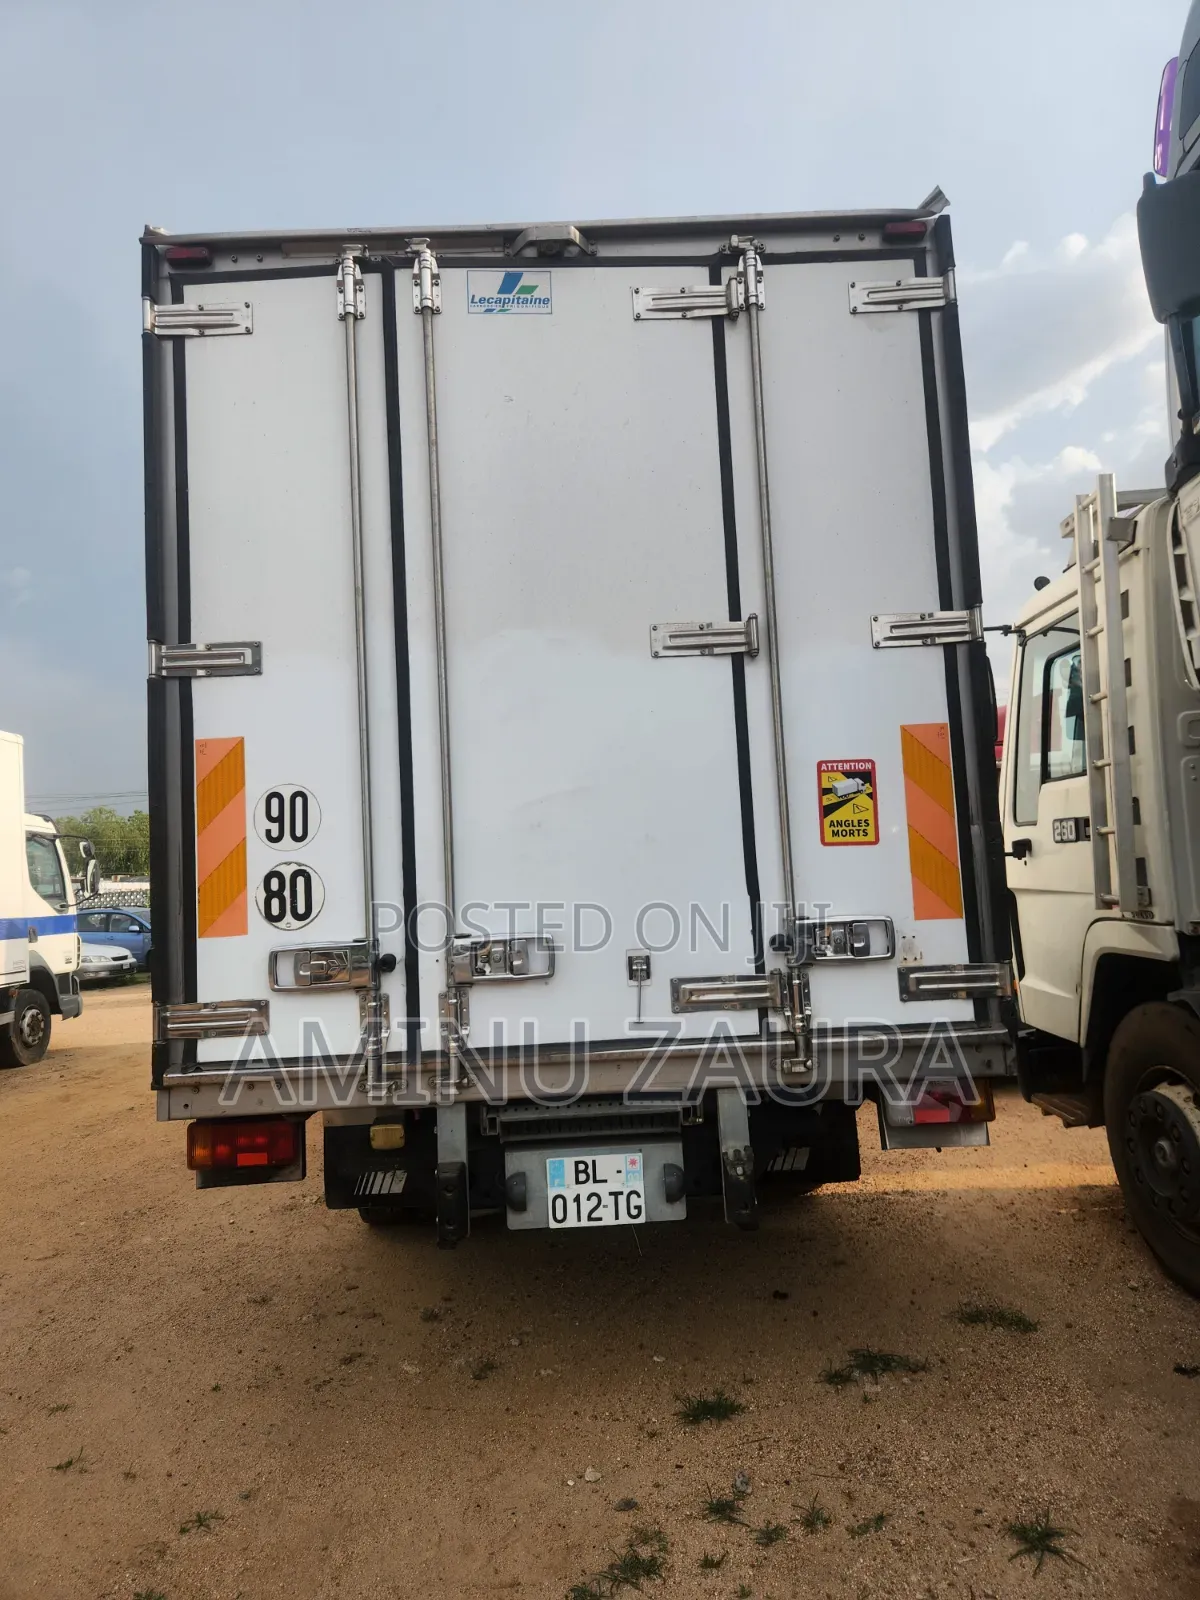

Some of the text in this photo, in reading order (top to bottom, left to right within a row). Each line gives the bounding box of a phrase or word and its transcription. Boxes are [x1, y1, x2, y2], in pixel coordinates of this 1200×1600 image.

[470, 294, 550, 308] Lecapitaine
[821, 762, 872, 771] ATTENTION
[265, 790, 309, 843] 90
[829, 819, 870, 828] ANGLES
[831, 828, 869, 838] MORTS
[1053, 820, 1076, 842] 260
[263, 868, 313, 923] 80
[551, 1190, 642, 1224] 012-TG
